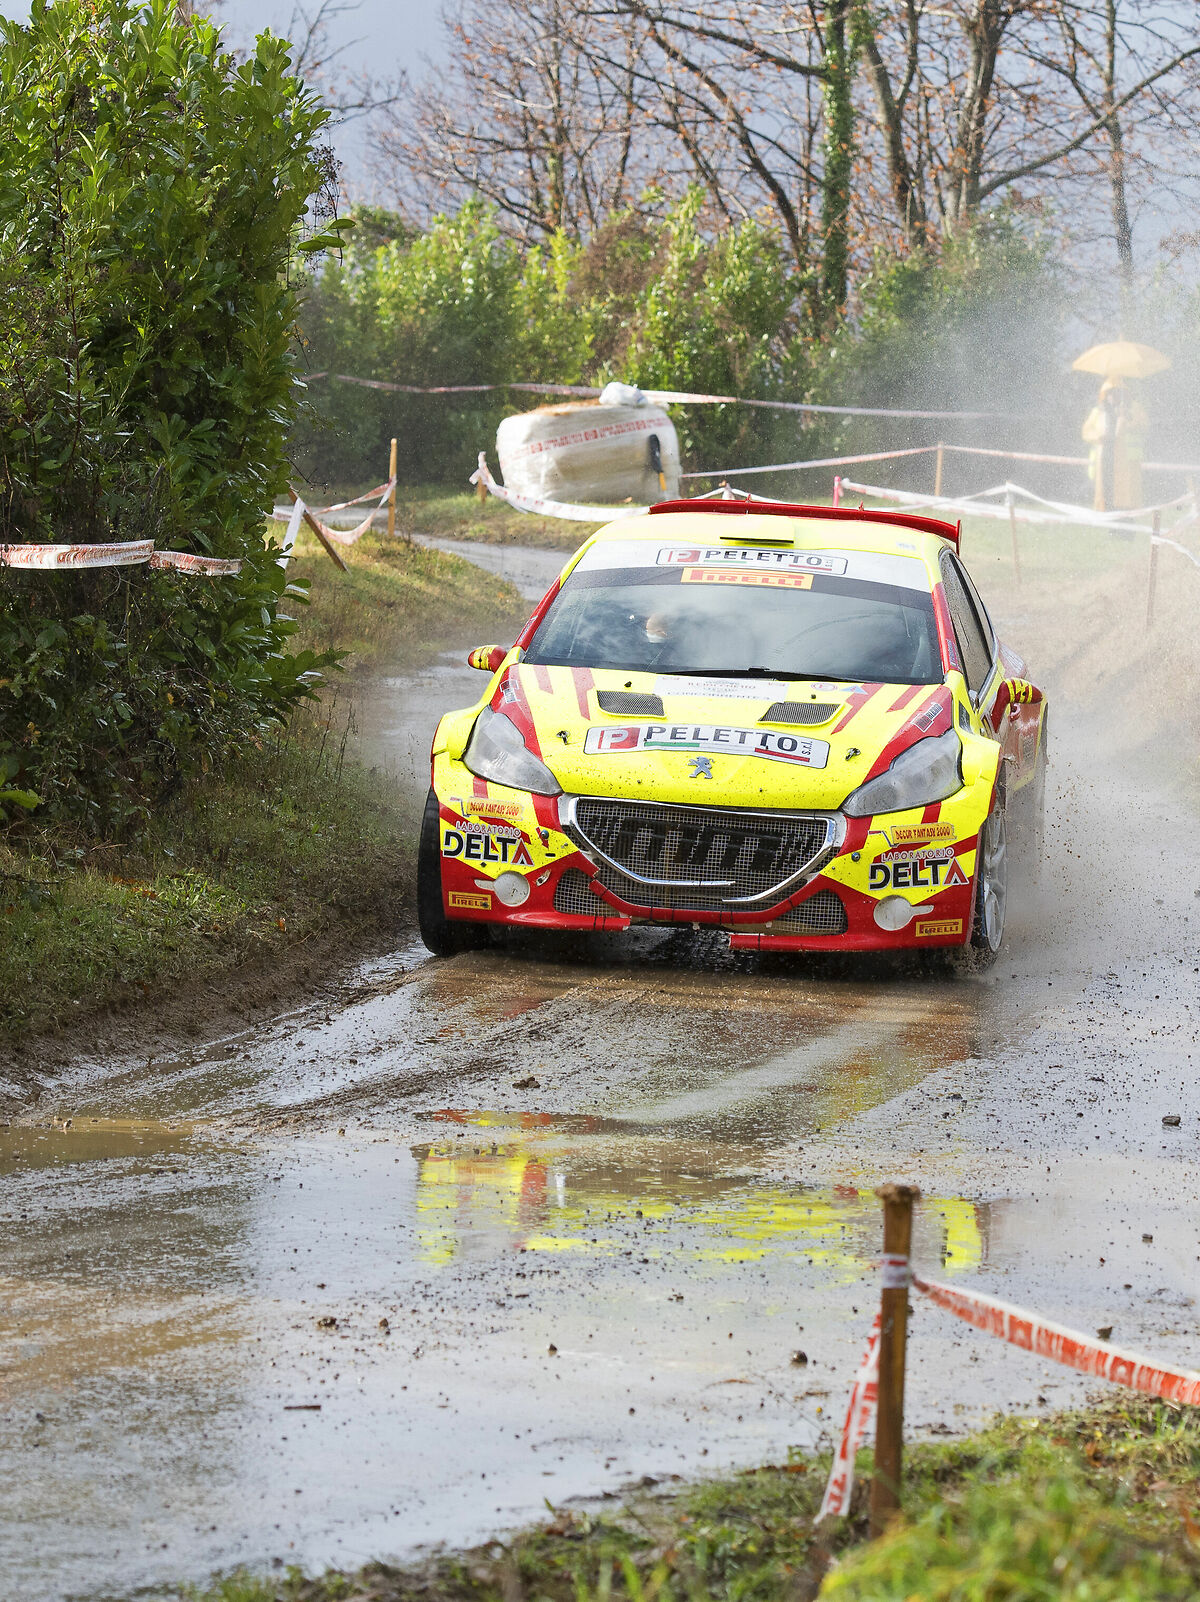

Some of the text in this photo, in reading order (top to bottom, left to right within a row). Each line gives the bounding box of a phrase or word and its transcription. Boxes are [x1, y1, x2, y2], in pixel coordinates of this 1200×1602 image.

[705, 550, 822, 566] PELETTO
[690, 569, 805, 586] PIRELLI
[646, 726, 798, 752] PELETTO
[455, 820, 521, 838] LABORATORIO
[936, 826, 951, 836] 2000
[443, 831, 534, 866] DELTA
[881, 847, 955, 862] LABORATORIO
[869, 857, 969, 890] DELTA
[919, 921, 959, 934] PIRELLI
